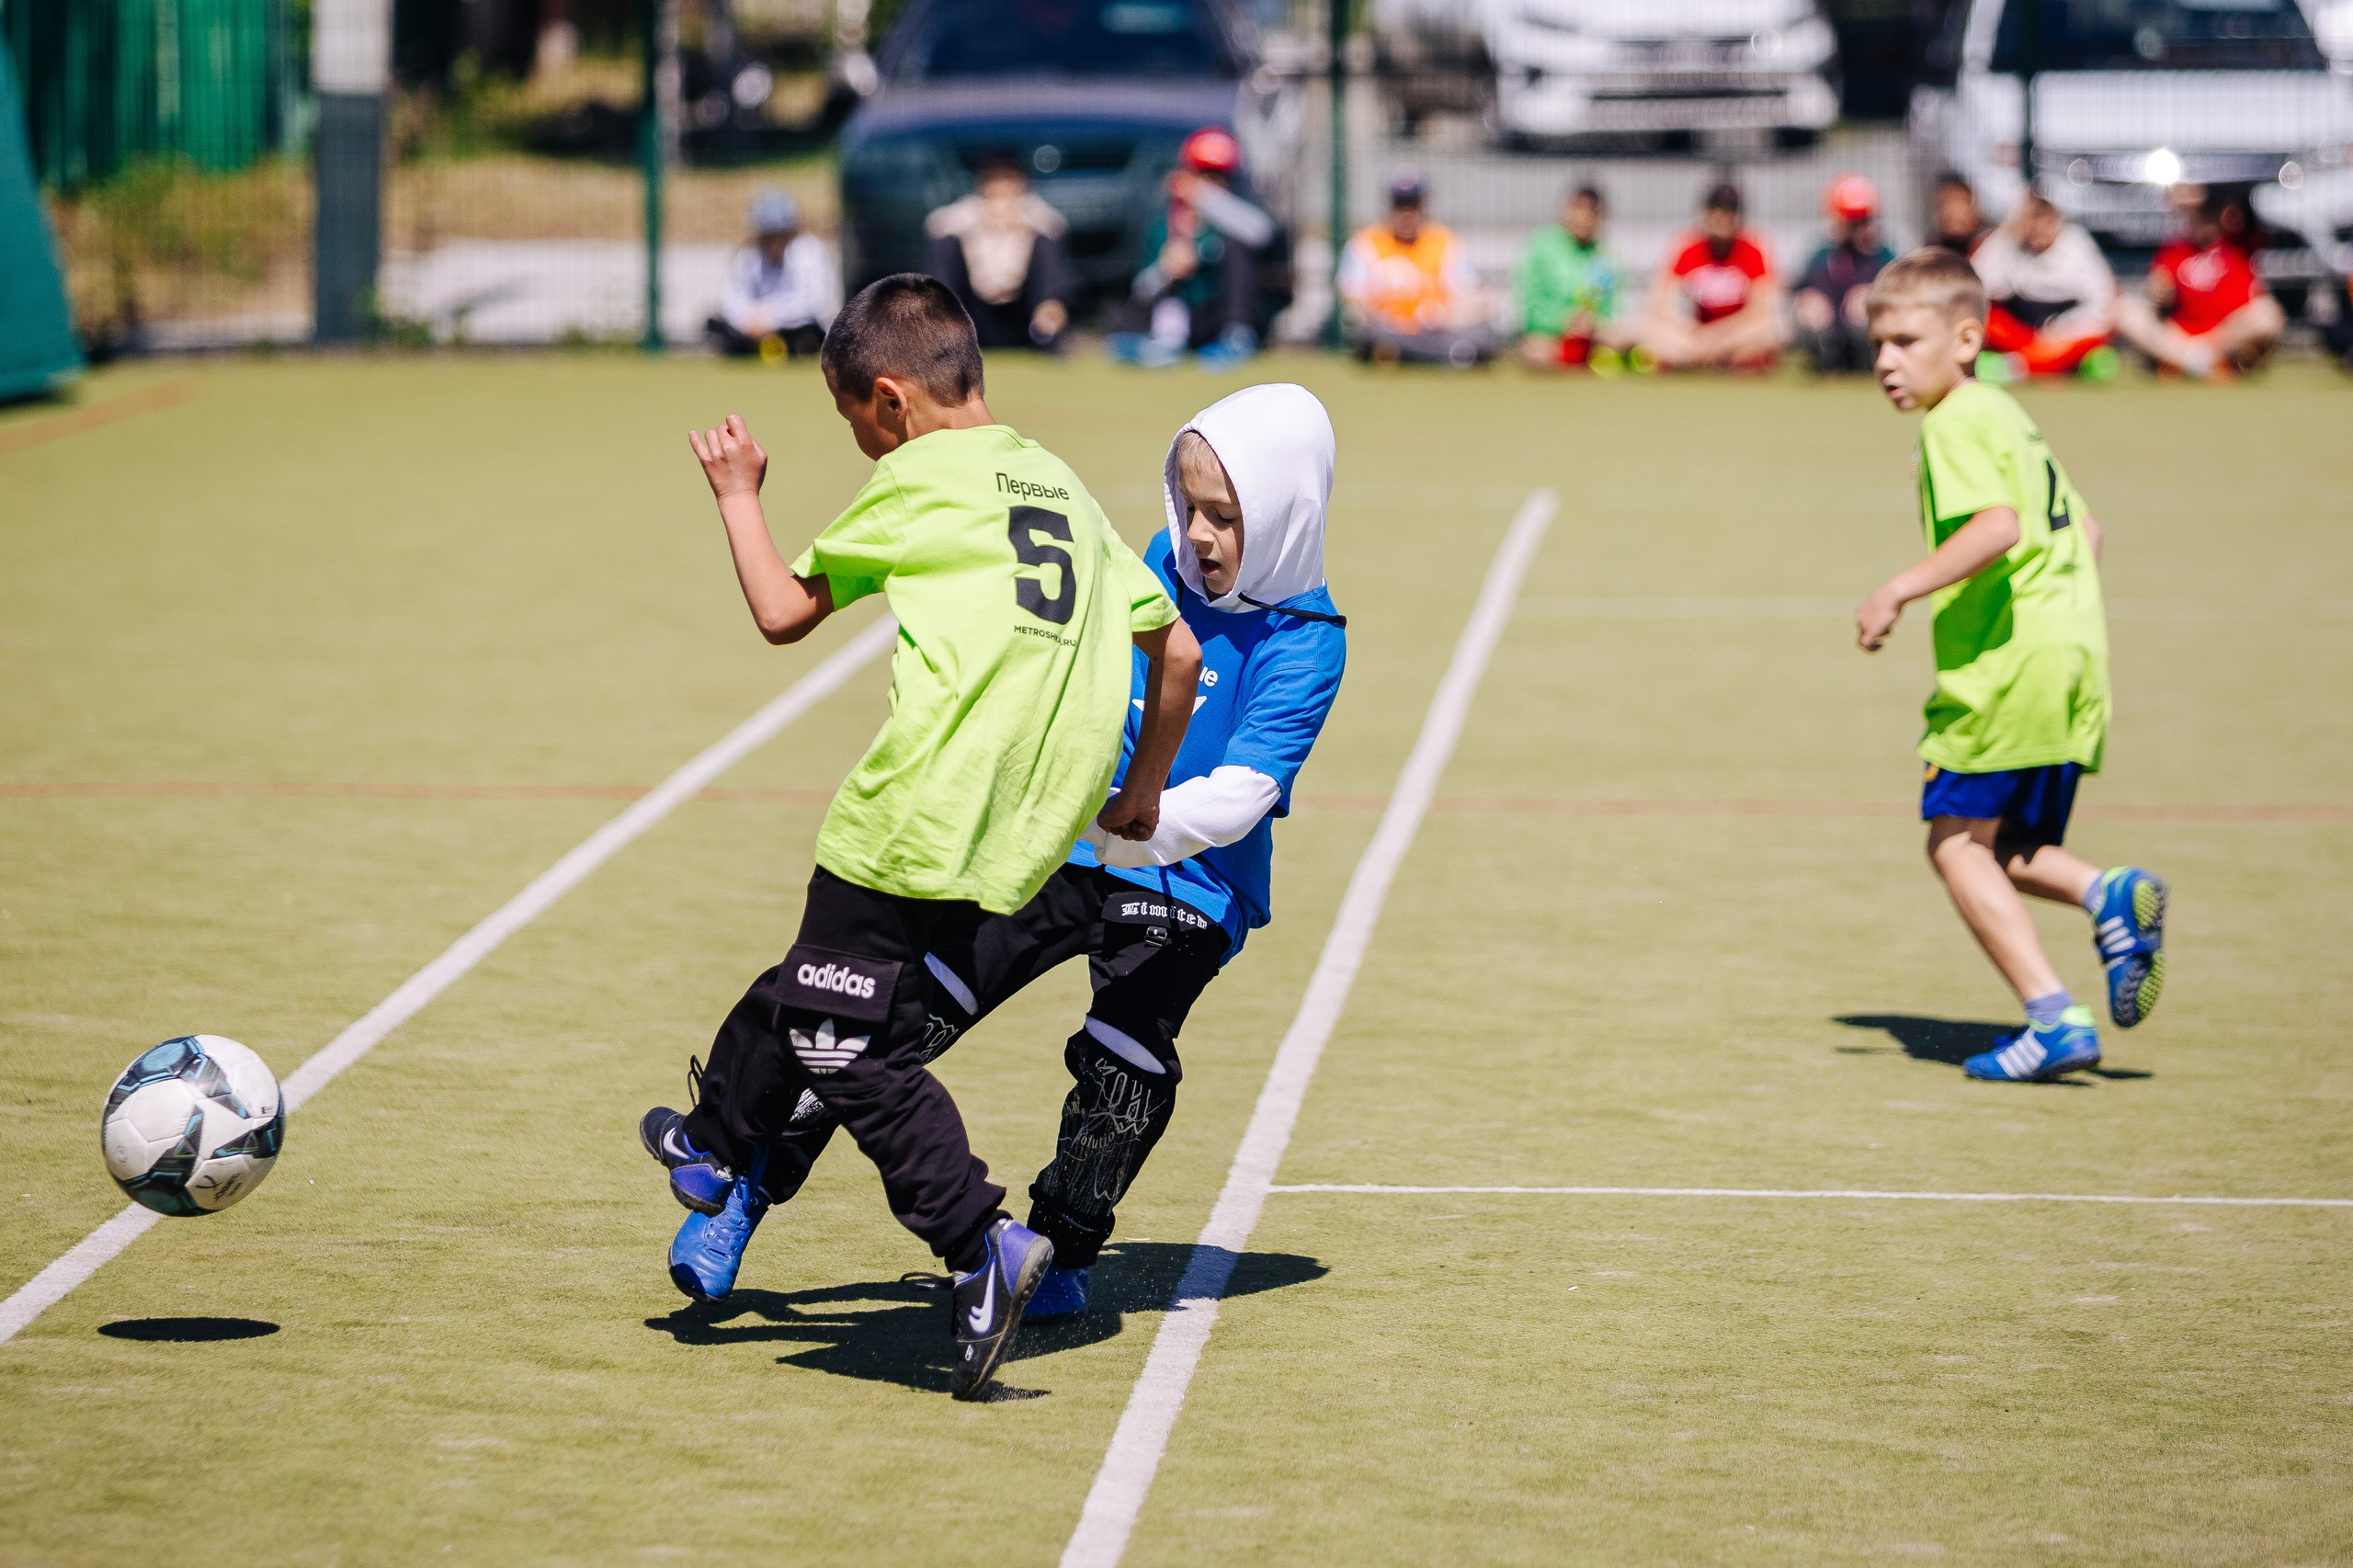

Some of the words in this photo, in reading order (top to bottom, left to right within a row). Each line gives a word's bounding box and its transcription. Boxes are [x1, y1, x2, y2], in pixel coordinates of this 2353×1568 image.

[995, 472, 1070, 501] Первые
[1007, 505, 1076, 625] 5
[797, 963, 876, 998] adidas
